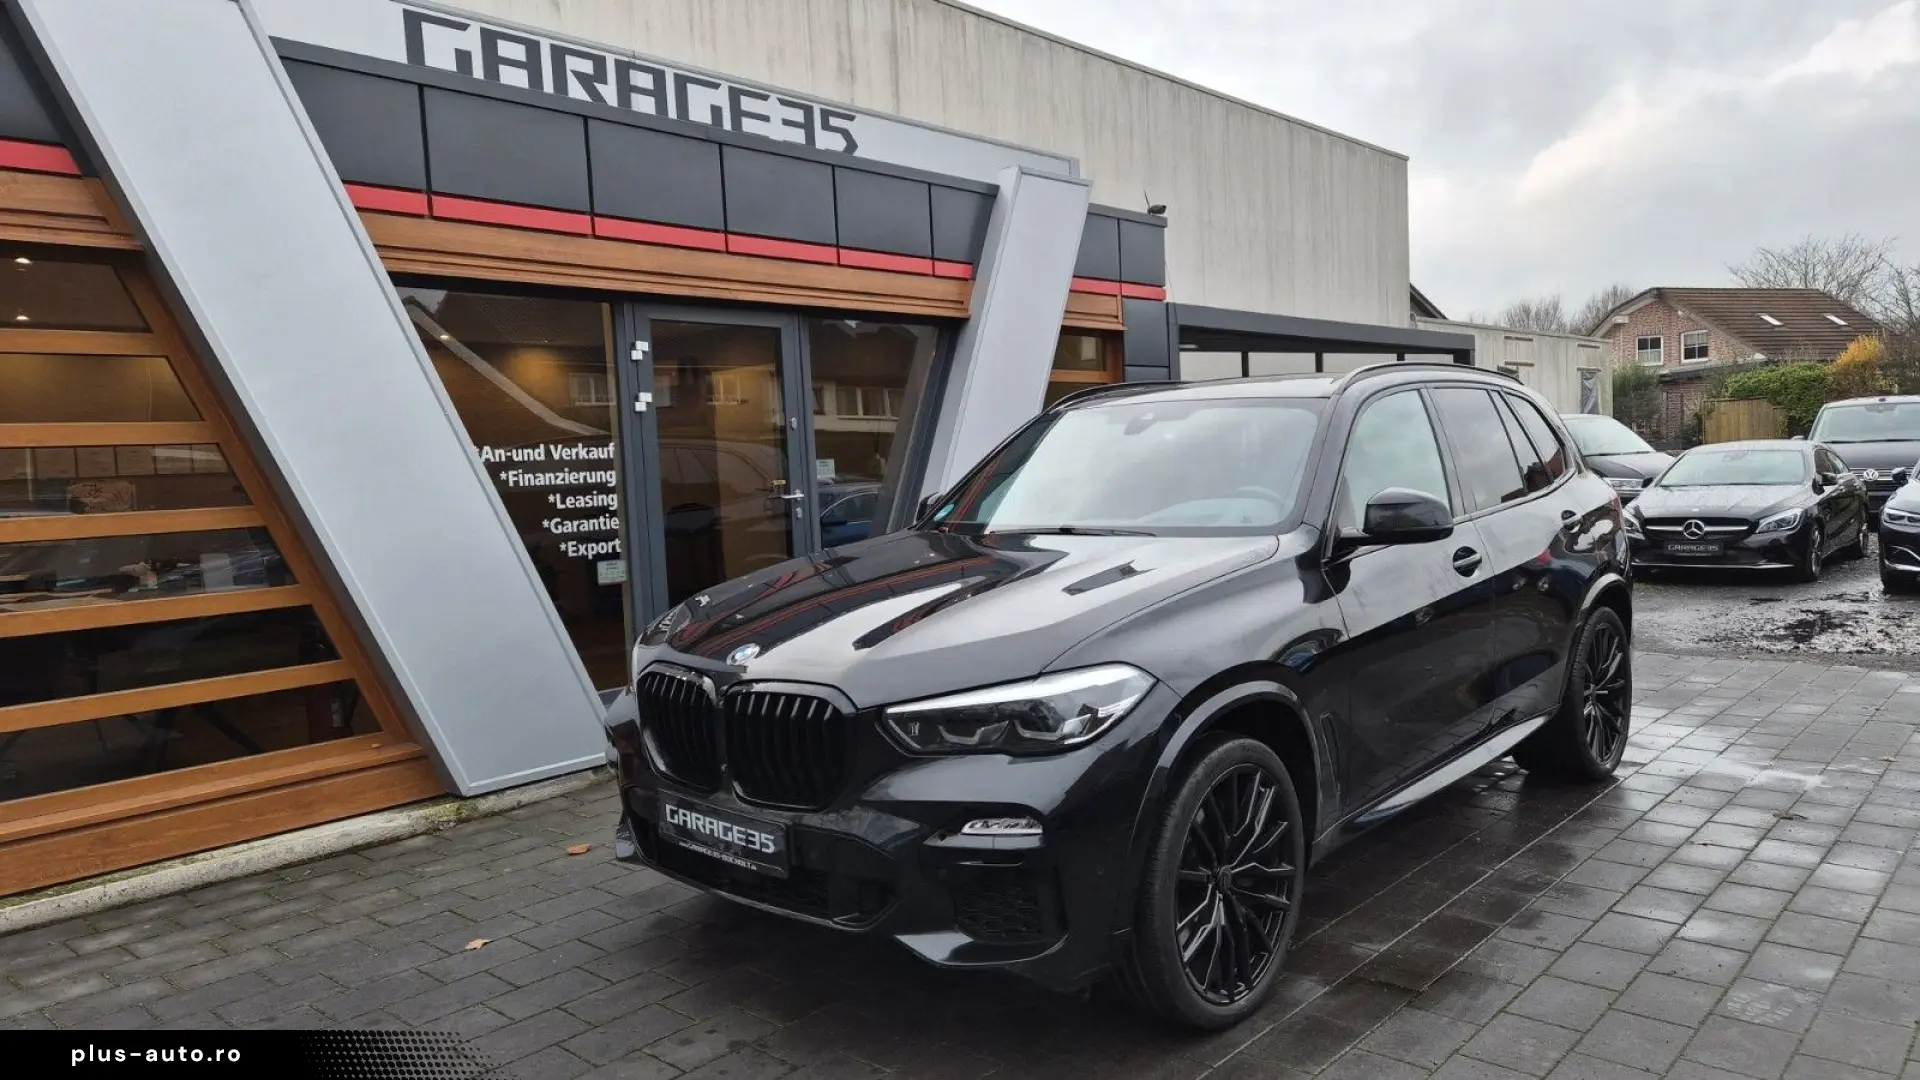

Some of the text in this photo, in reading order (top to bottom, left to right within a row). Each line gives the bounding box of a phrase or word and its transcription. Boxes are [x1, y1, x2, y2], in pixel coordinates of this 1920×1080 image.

[402, 8, 859, 156] GARAGE35
[550, 442, 615, 461] Verkauf
[665, 803, 776, 854] GARAGE35
